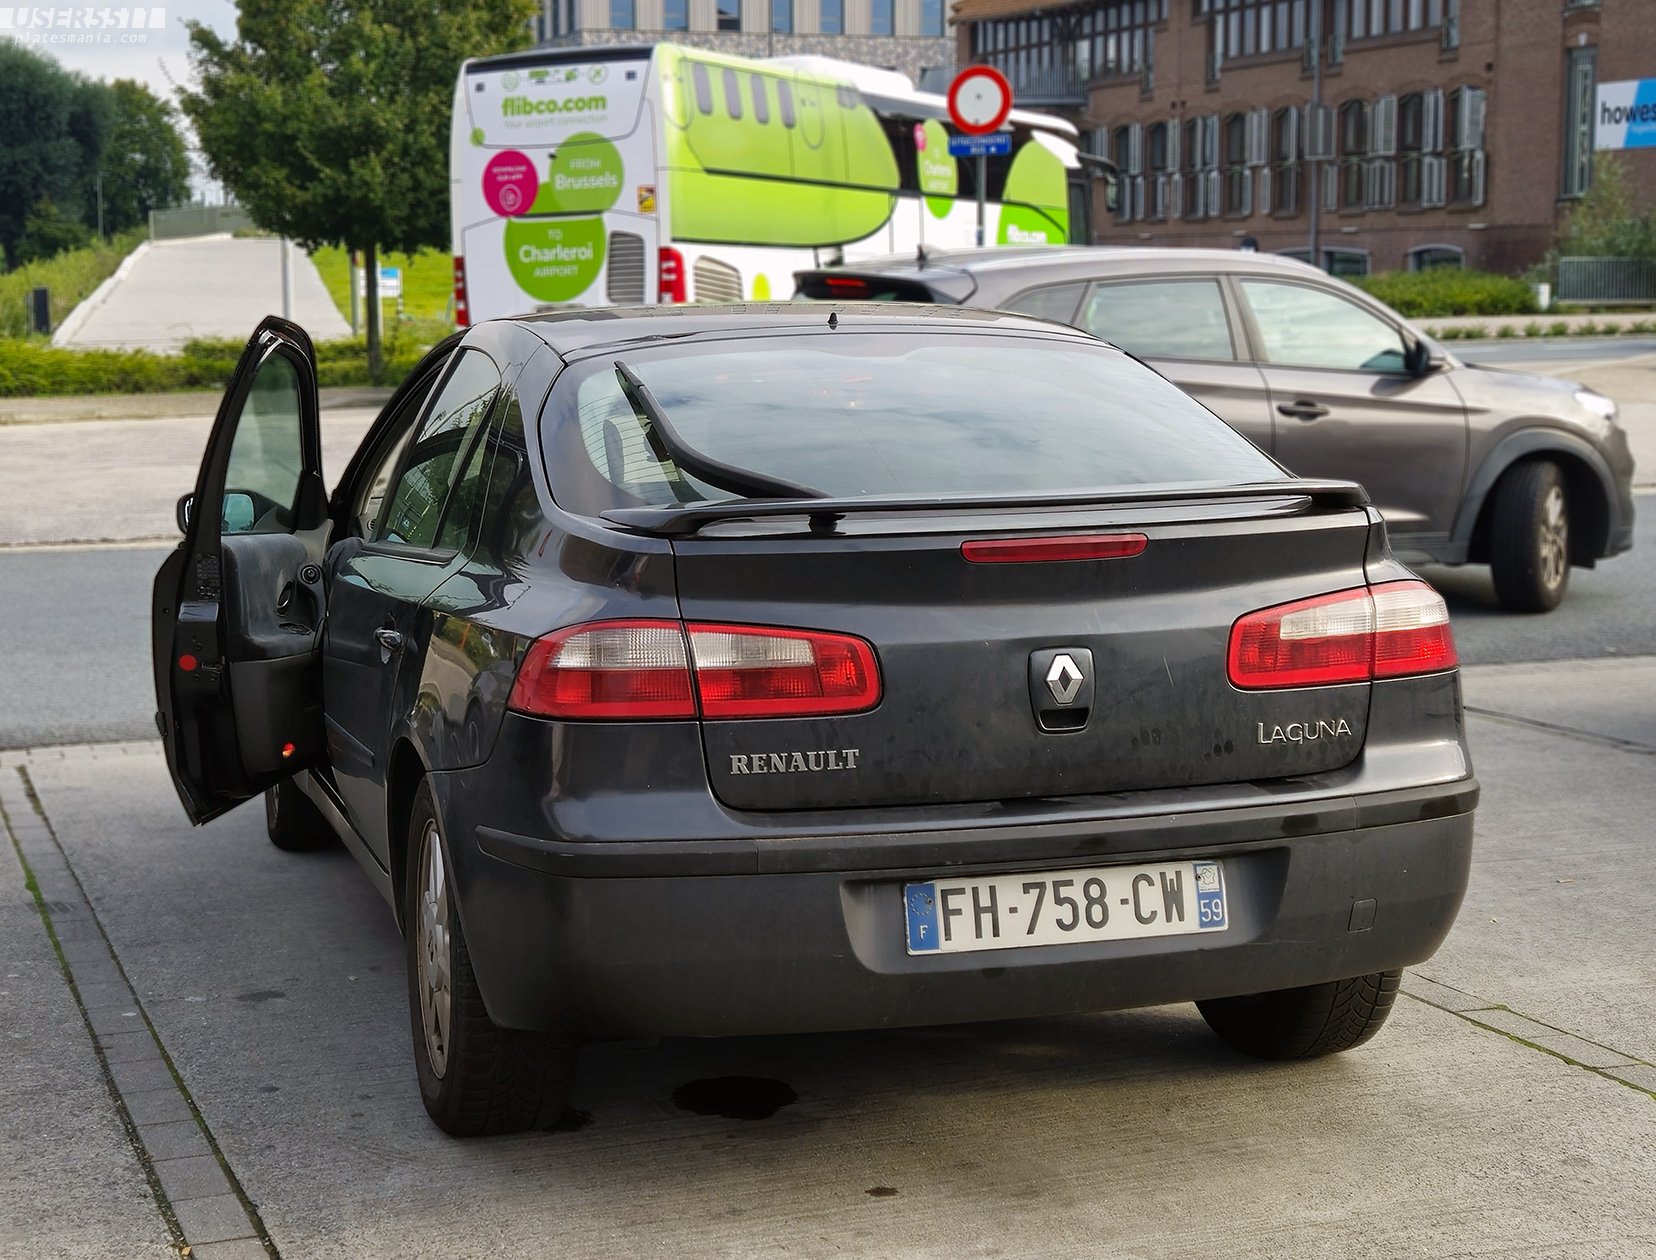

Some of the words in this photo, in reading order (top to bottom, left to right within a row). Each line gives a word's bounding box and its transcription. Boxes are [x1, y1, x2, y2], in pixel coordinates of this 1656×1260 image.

[502, 95, 607, 117] flibco.com
[570, 158, 601, 169] FROM
[554, 171, 618, 190] Brussels
[547, 228, 563, 241] TO
[519, 242, 594, 263] Charleroi
[533, 264, 578, 277] AIRPORT
[1257, 719, 1352, 745] LAGUNA
[729, 749, 860, 775] RENAULT
[940, 870, 1185, 941] FH-758-CW
[1200, 899, 1223, 922] 59
[919, 925, 928, 941] F
